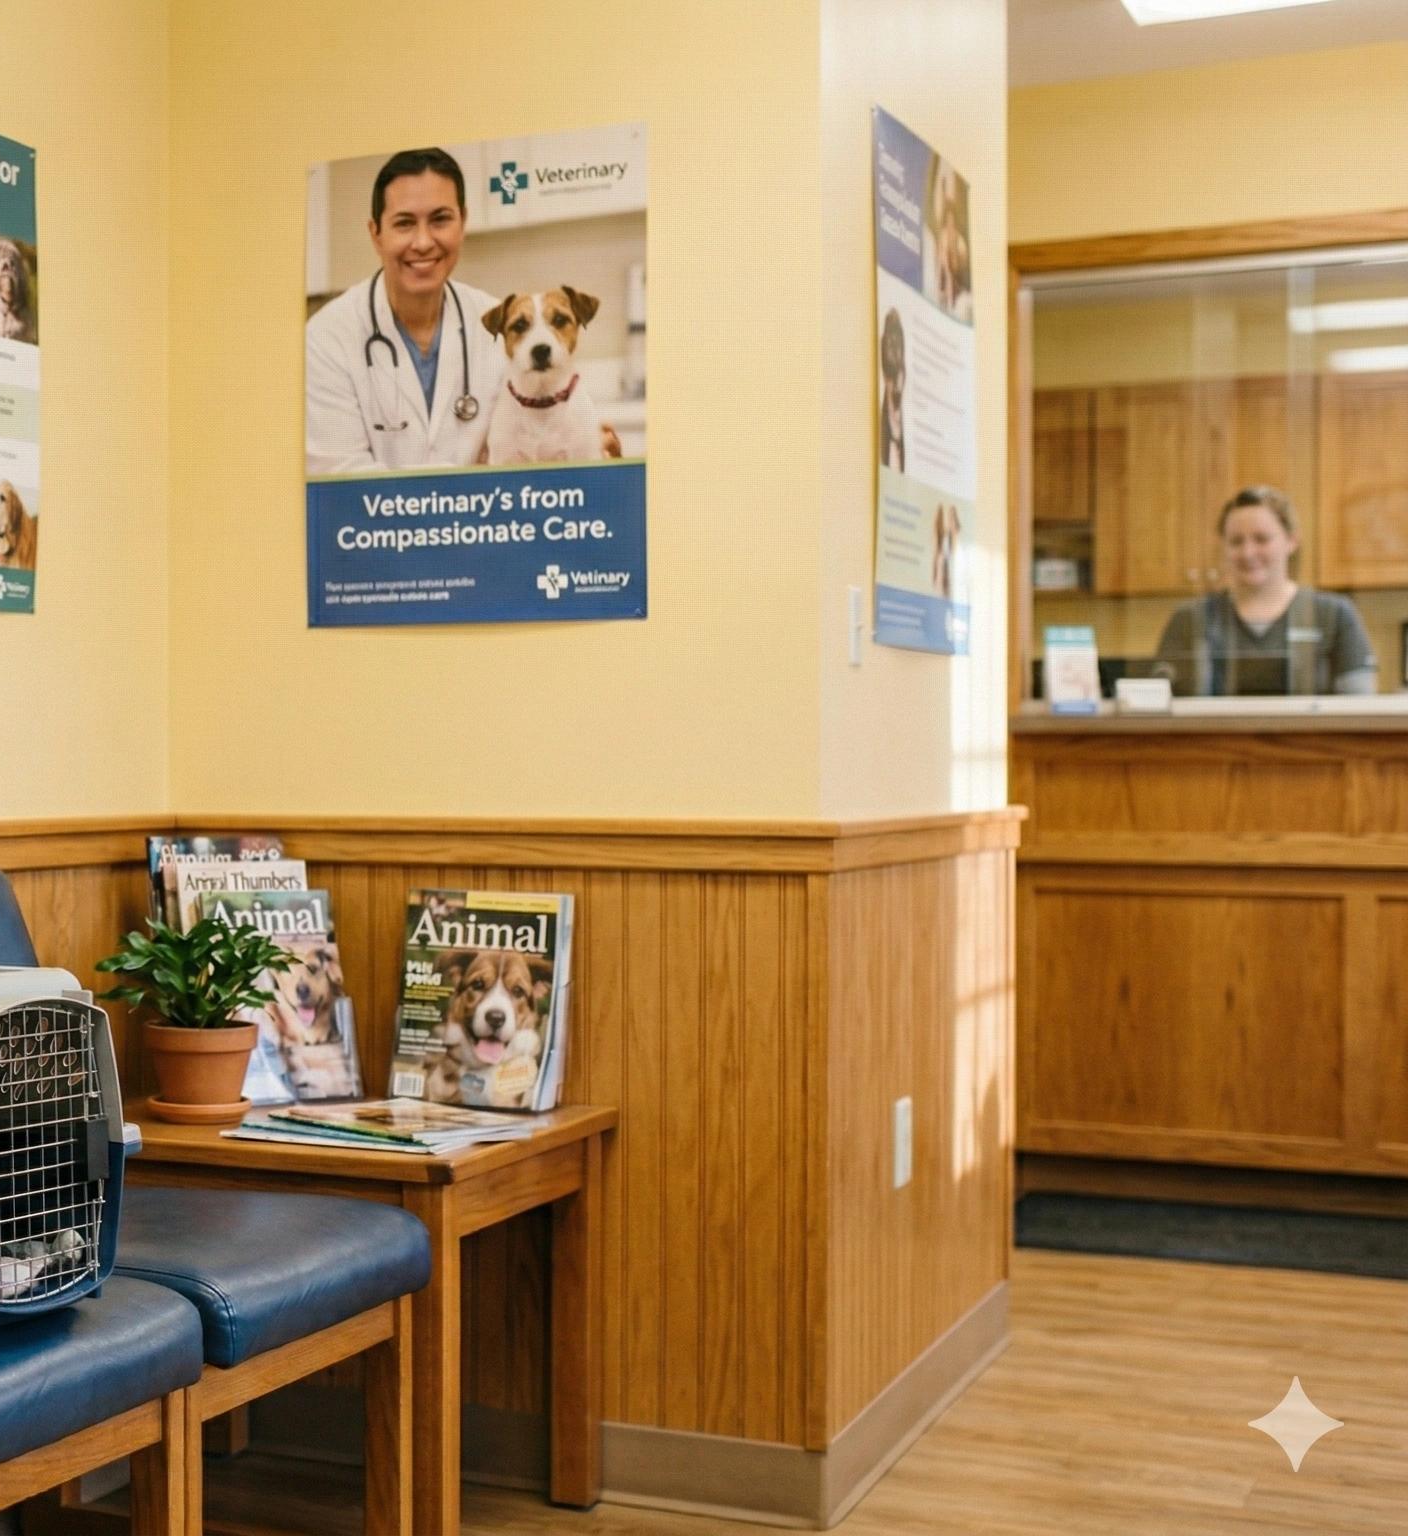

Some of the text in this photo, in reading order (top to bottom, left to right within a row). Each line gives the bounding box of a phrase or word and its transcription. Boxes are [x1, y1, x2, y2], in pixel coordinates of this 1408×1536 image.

[535, 162, 628, 184] Veterinary
[363, 485, 584, 517] Veterinary's from
[337, 516, 613, 552] Compassionate Care.
[212, 898, 327, 935] Animal
[407, 908, 548, 954] Animal
